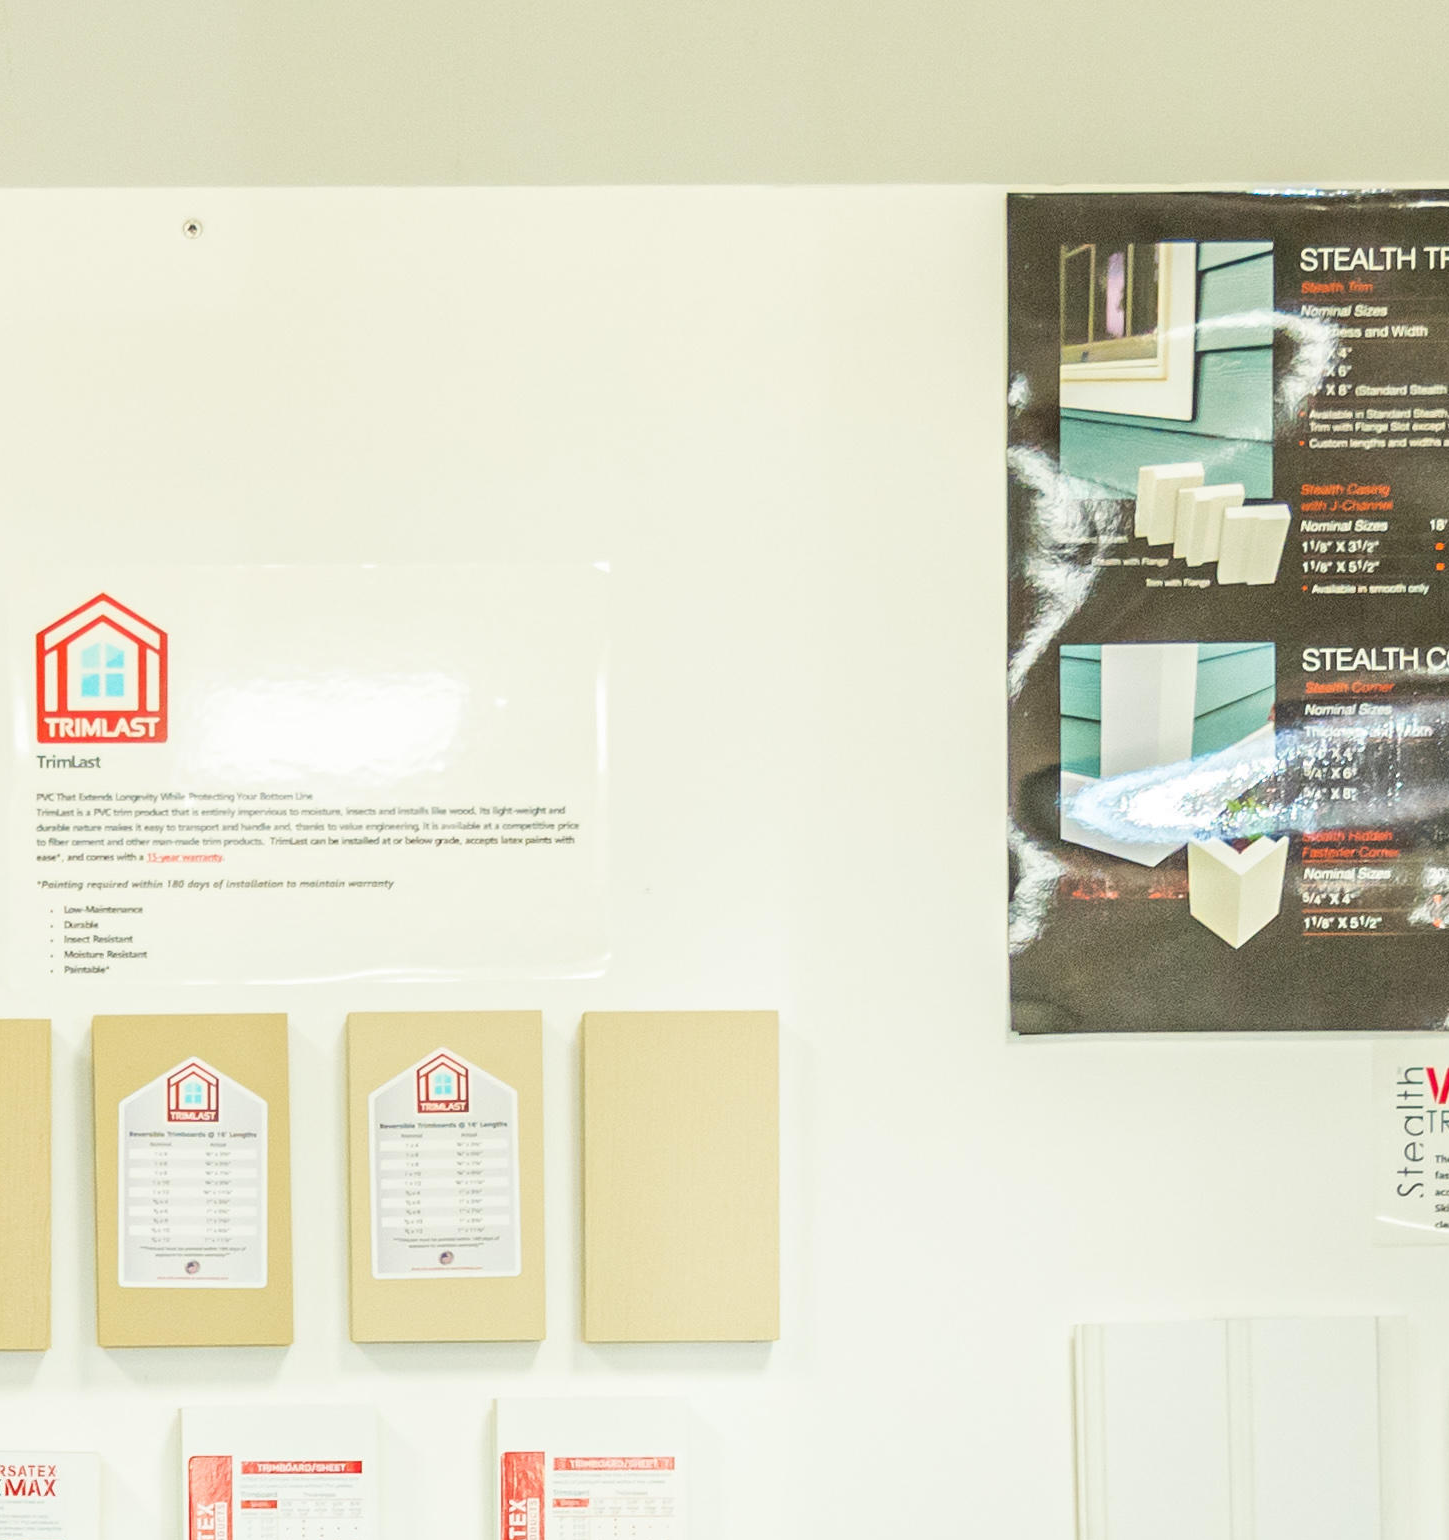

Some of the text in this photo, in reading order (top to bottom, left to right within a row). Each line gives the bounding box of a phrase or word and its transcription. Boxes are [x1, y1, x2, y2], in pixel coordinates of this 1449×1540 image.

[1300, 247, 1415, 271] STEALTH
[1301, 305, 1351, 318] Nominal
[1302, 647, 1421, 672] STEALTH
[45, 717, 159, 738] TRIMLAST
[37, 754, 101, 770] TrimLast
[64, 920, 99, 930] Durable
[93, 934, 133, 944] Resistant
[420, 1101, 466, 1112] TRIMLAST
[170, 1110, 217, 1121] TRIMLAST
[1397, 1066, 1425, 1198] Stealth
